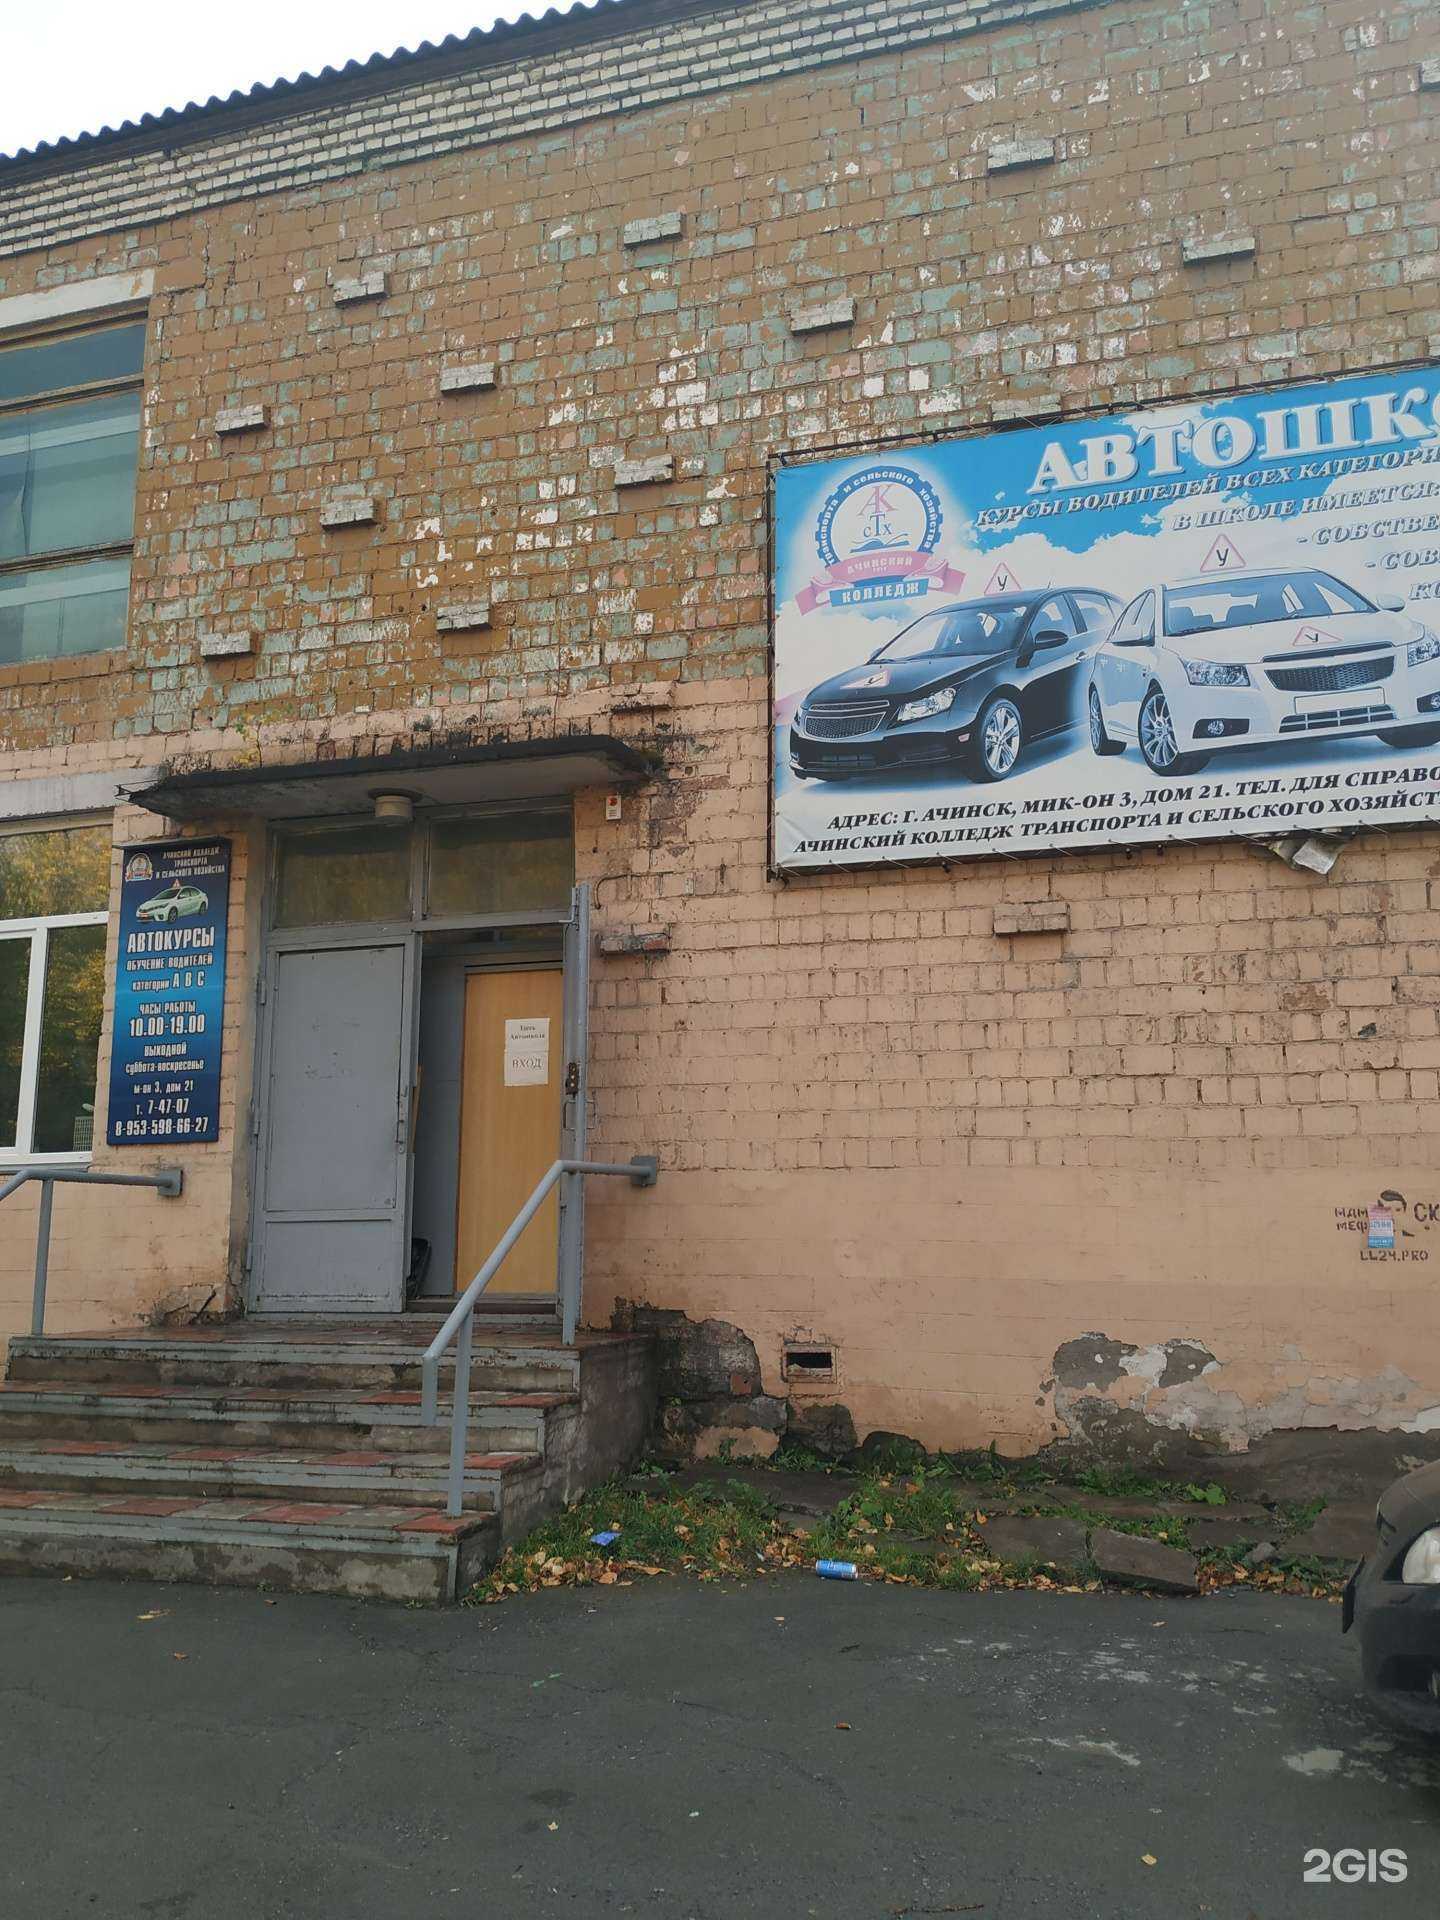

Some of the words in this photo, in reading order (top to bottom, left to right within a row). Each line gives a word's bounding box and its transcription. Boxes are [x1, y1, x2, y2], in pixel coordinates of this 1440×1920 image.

[976, 500, 1063, 527] КУРСЫ
[1067, 472, 1220, 513] ВОДИТЕЛЕЙ
[1225, 465, 1295, 492] ВСЕХ
[1172, 513, 1192, 531] В
[1195, 500, 1297, 528] ШКОЛЕ
[842, 582, 919, 603] КОЛЛЕДЖ
[827, 813, 899, 831] АДРЕС:
[902, 810, 920, 823] Г.
[922, 801, 1017, 822] АЧИНСК,
[1021, 793, 1116, 814] МИК-ОН
[1118, 791, 1137, 808] 3,
[1140, 786, 1194, 807] ДОМ
[1198, 784, 1230, 800] 21.
[1235, 778, 1287, 796] ТЕЛ.
[1288, 773, 1340, 794] ДЛЯ
[793, 830, 908, 853] АЧИНСКИЙ
[911, 825, 1014, 845] КОЛЛЕДЖ
[1020, 814, 1162, 837] ТРАНСПОРТА
[1166, 811, 1183, 825] И
[1188, 799, 1325, 824] СЕЛЬСКОГО
[127, 926, 215, 953] АВТОКУРСЫ
[126, 956, 165, 971] ОБУЧЕНИЕ
[168, 953, 213, 969] ВОДИТЕЛЕЙ
[139, 1003, 161, 1014] ЧАСЫ
[164, 1001, 196, 1013] РАБОТЫ
[129, 1014, 205, 1037] 10.00-19.00
[144, 1042, 187, 1057] ВЫХОДНОЙ
[512, 1058, 543, 1070] ВХОД
[166, 1083, 181, 1094] дом
[184, 1080, 194, 1091] 21
[148, 1098, 189, 1114] 7-47-07
[115, 1117, 209, 1137] 8-953-598-66-27
[1360, 1250, 1429, 1262] LL24.PRO
